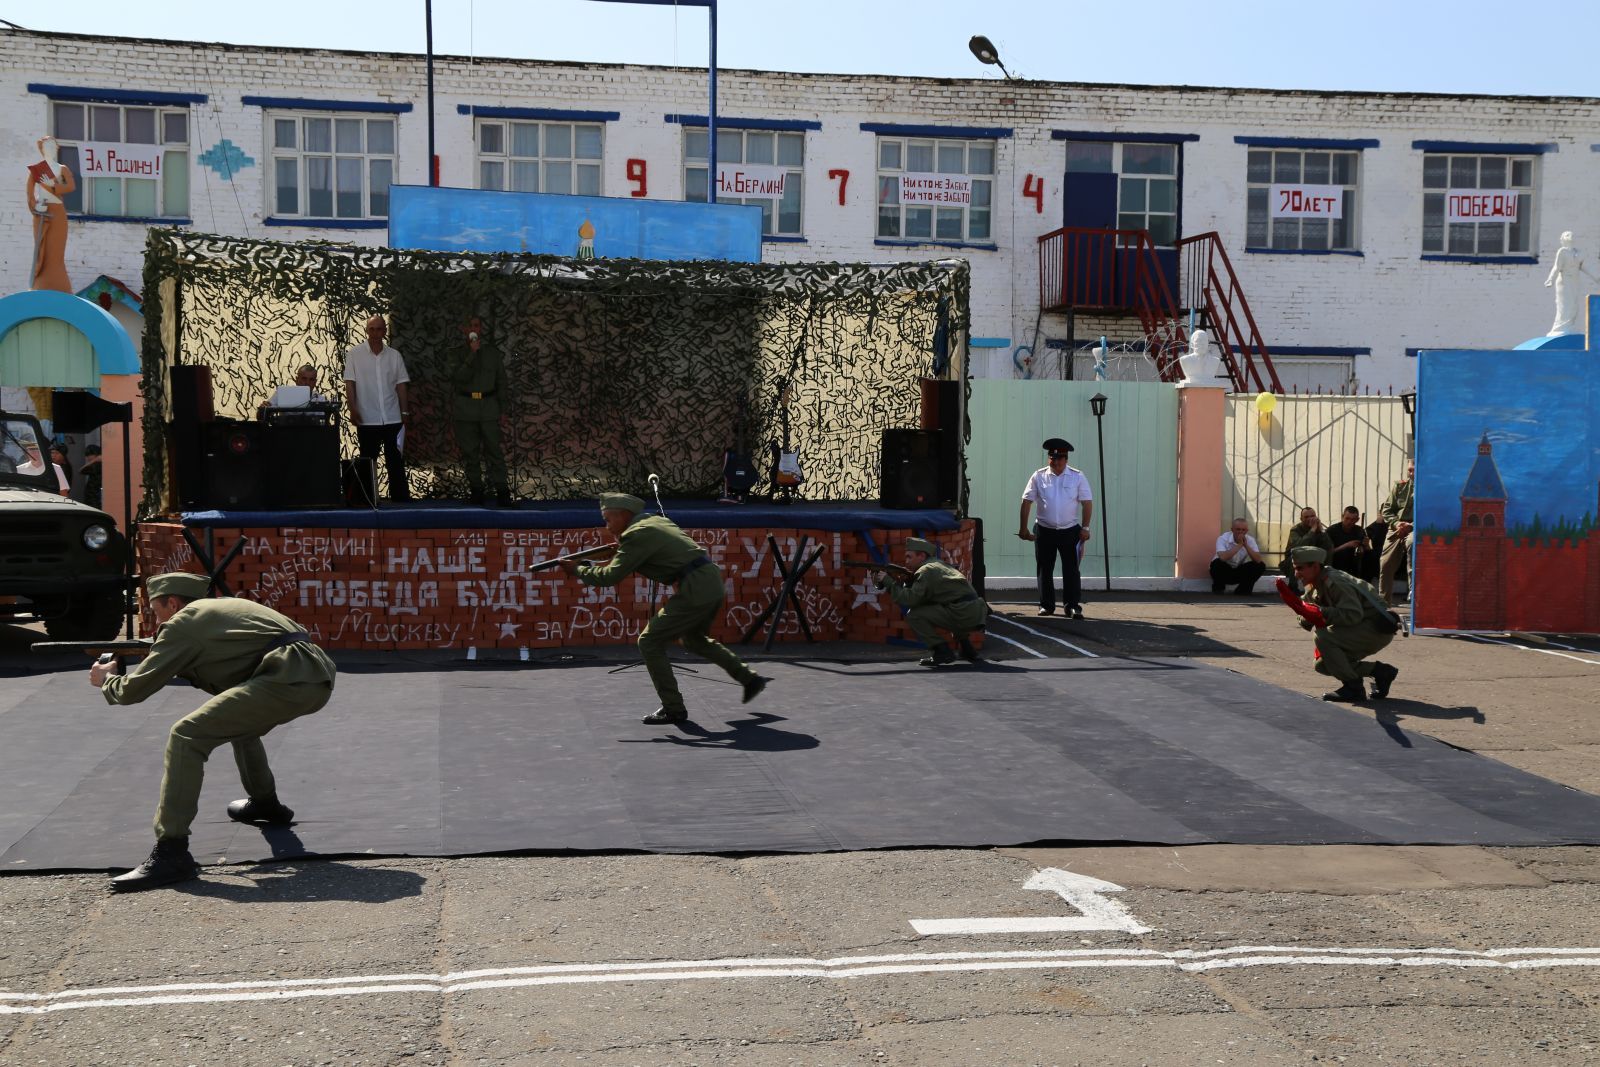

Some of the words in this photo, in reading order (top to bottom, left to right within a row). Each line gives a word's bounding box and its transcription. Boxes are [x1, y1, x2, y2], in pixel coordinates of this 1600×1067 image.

[626, 158, 648, 198] 9
[828, 169, 849, 206] 7
[1022, 173, 1044, 214] 4
[1449, 194, 1518, 217] ПОБЕДЫ
[242, 537, 273, 556] НА
[387, 546, 487, 574] НАШЕ
[298, 579, 440, 617] ПОБЕДА
[456, 579, 565, 613] БУДЕТ
